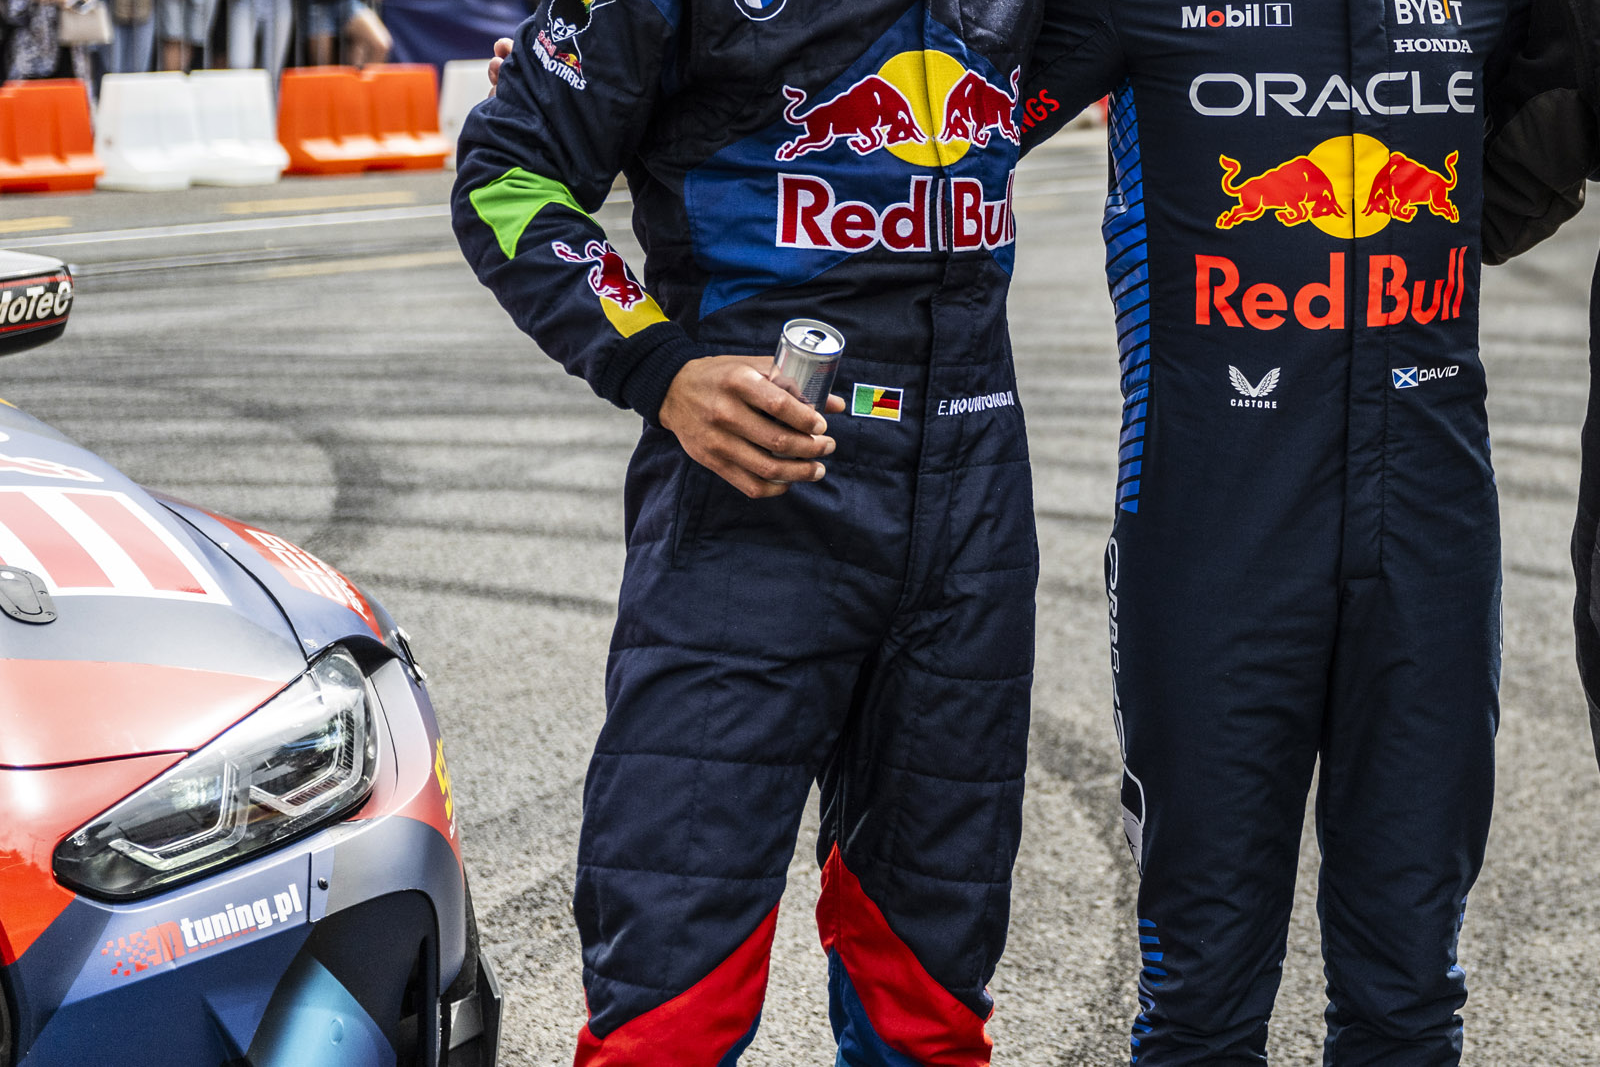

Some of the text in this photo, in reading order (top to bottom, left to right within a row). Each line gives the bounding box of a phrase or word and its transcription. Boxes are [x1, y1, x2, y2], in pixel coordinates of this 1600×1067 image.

[1182, 3, 1286, 29] Mobil 1
[1394, 38, 1474, 54] HONDA
[1188, 71, 1476, 118] ORACLE
[776, 168, 1015, 253] Red Bull
[1194, 246, 1468, 330] Red Bull
[1418, 365, 1459, 382] DAVID
[1230, 398, 1278, 410] CASTORE
